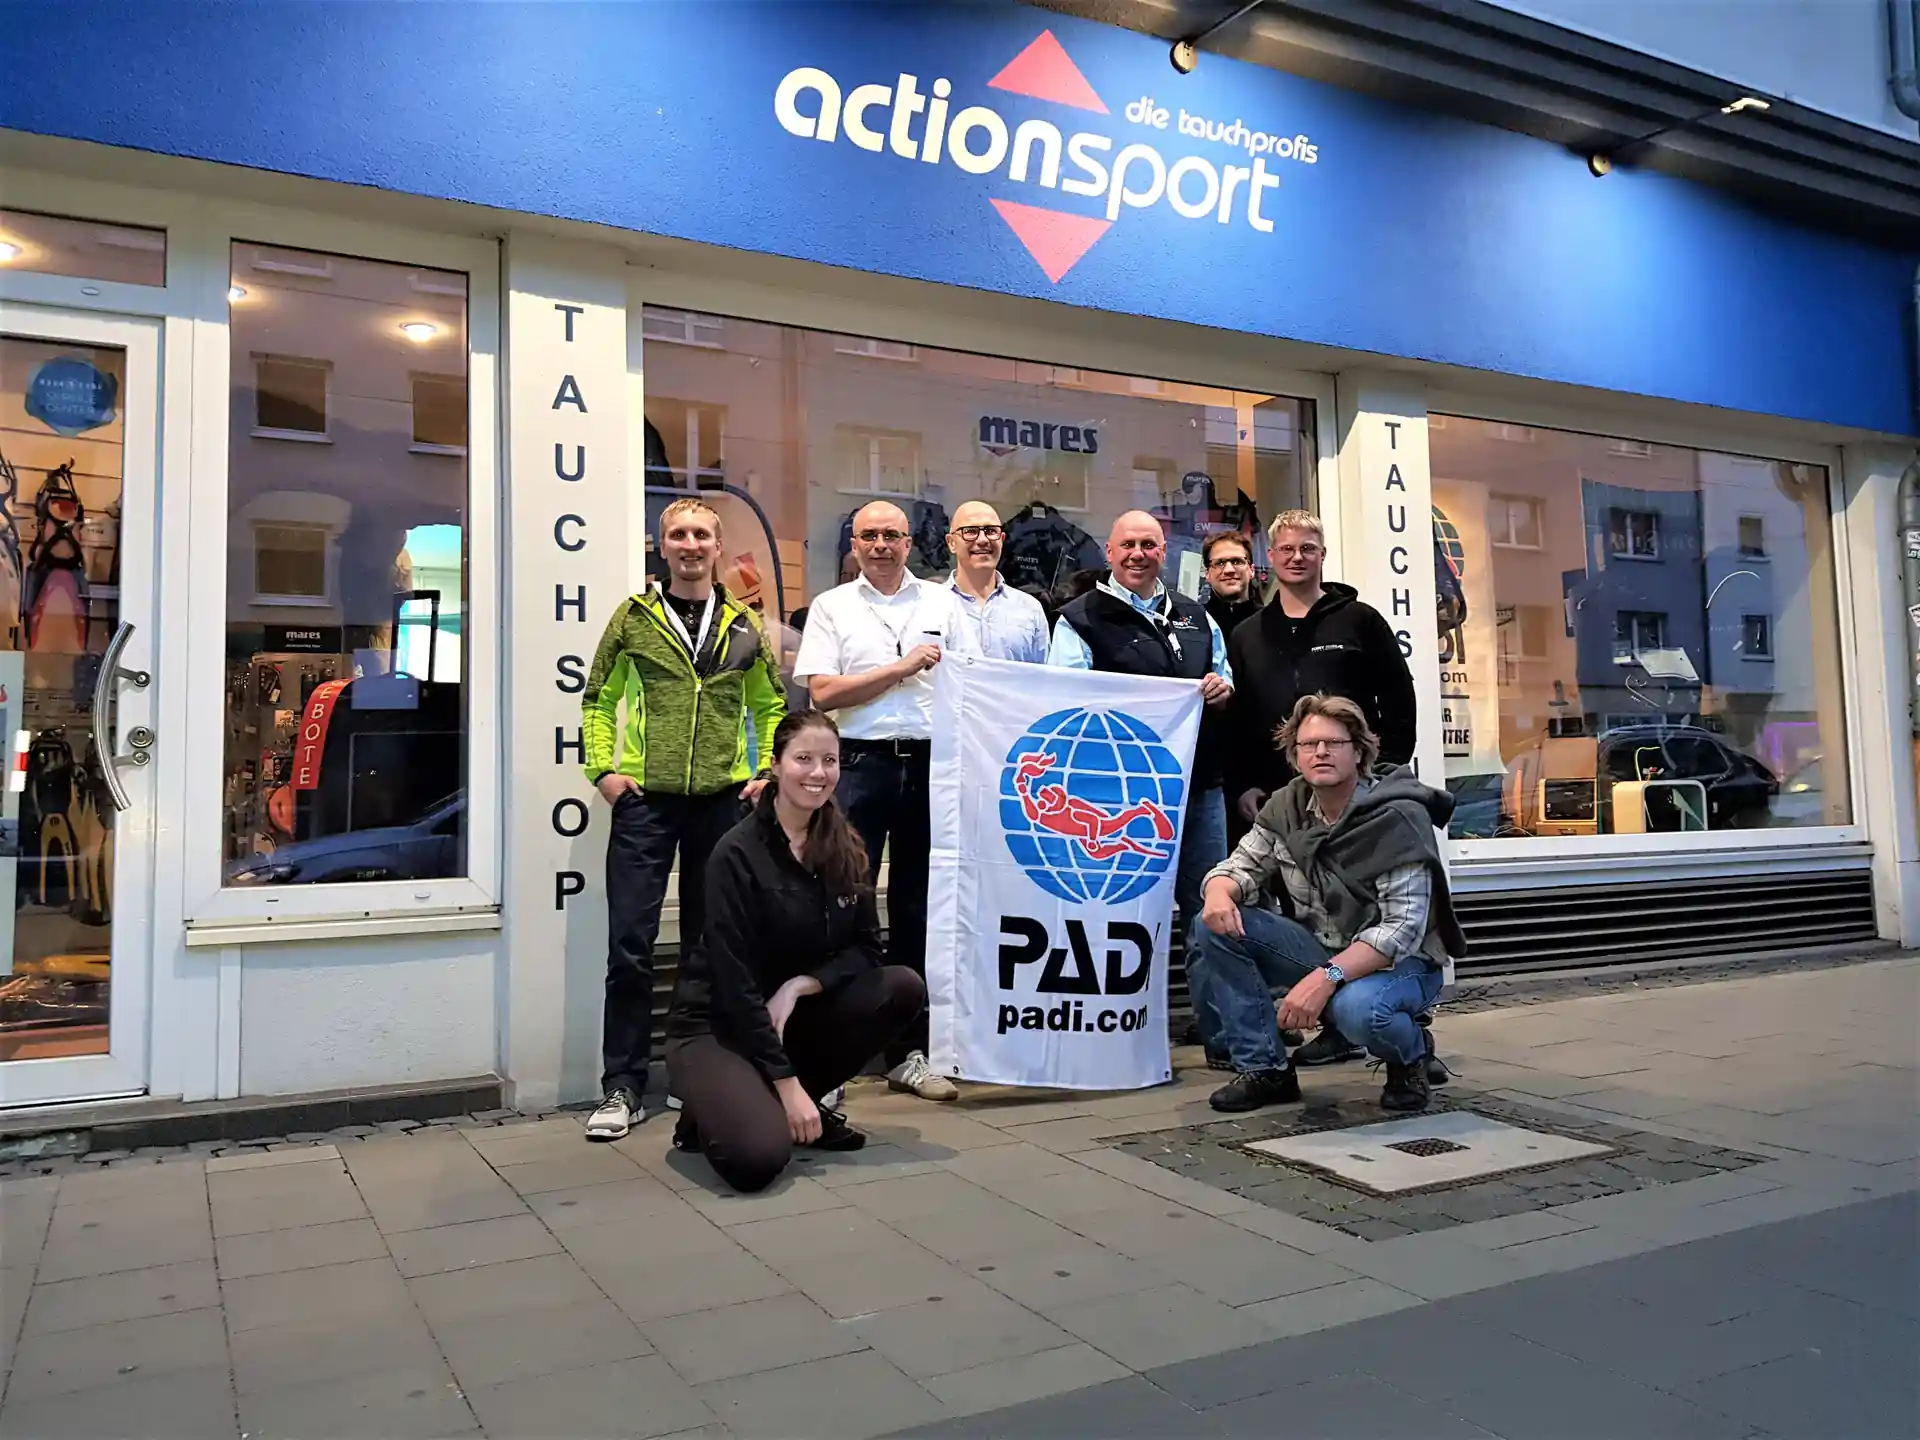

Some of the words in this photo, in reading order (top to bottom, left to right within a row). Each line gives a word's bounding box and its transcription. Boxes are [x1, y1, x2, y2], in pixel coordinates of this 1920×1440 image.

[774, 67, 1280, 233] actionsport
[1125, 96, 1170, 130] die
[1178, 108, 1318, 164] tauchprofis
[979, 416, 1098, 454] mares
[286, 631, 321, 640] mares
[551, 304, 590, 911] TAUCHSHOP
